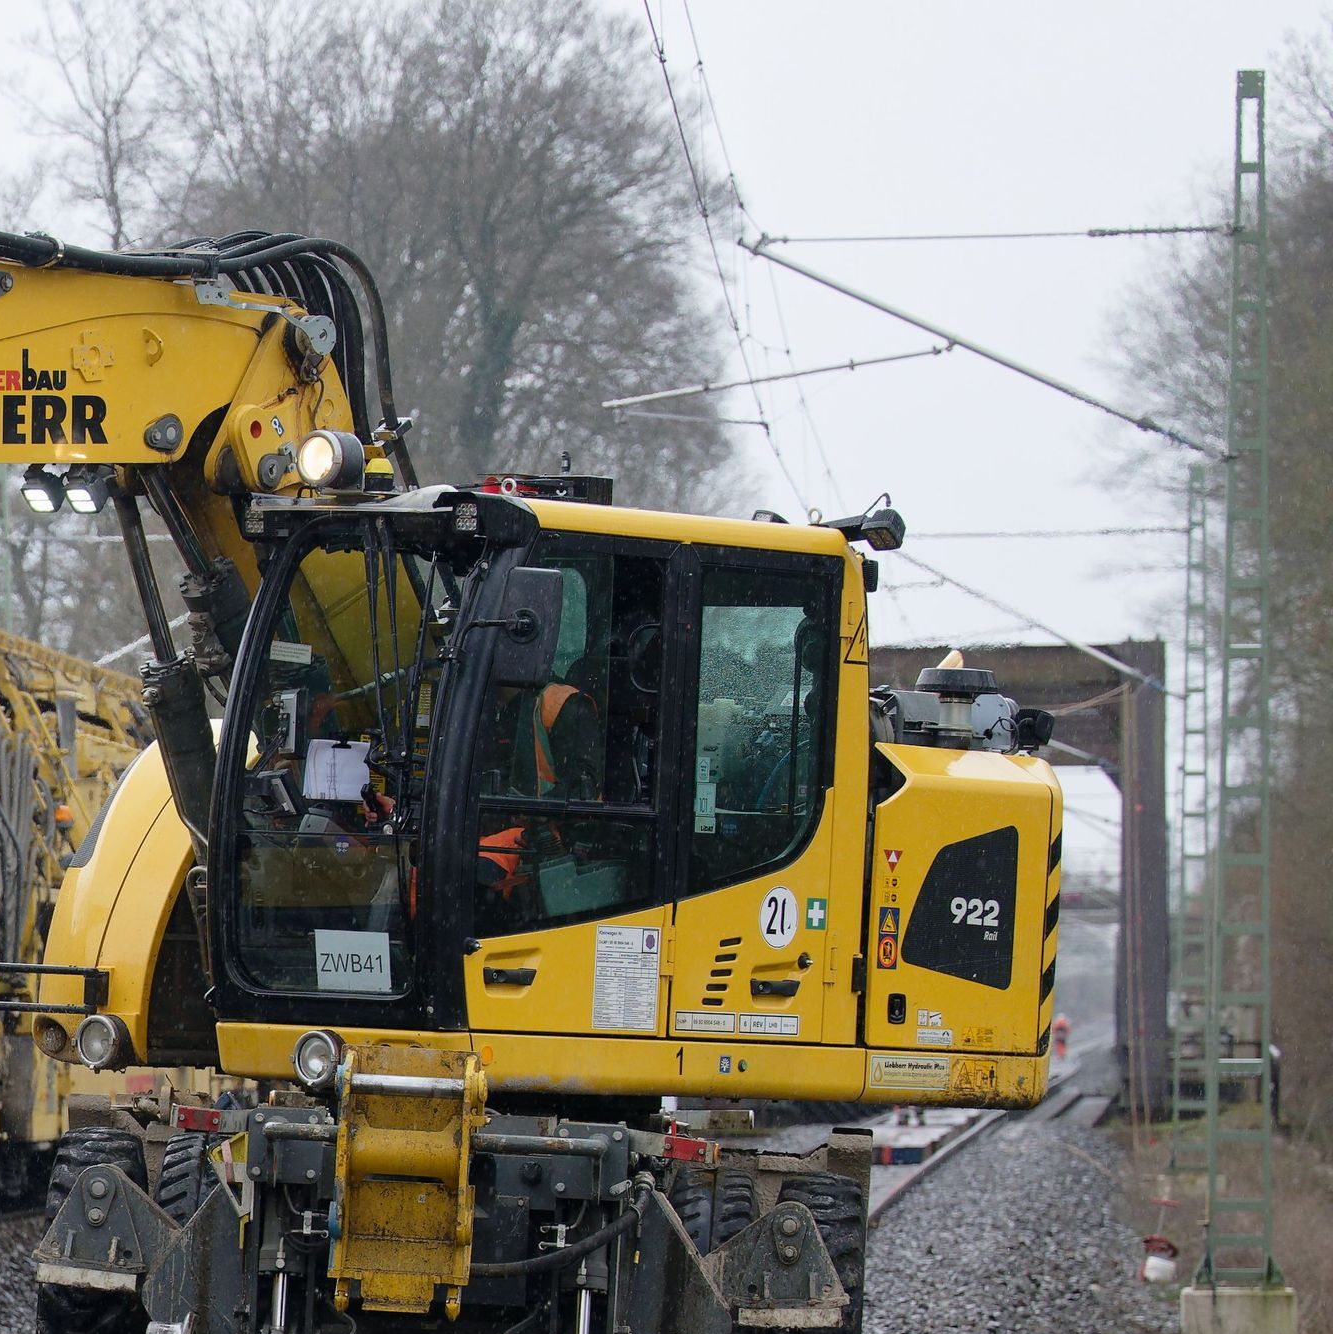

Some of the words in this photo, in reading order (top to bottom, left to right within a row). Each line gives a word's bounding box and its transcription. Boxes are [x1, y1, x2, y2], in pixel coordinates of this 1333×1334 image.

[950, 896, 1000, 927] 922
[983, 930, 999, 941] Rail
[320, 952, 383, 974] ZWB41
[752, 1020, 764, 1029] REV
[676, 1046, 684, 1076] 1
[884, 1061, 907, 1069] Liebherr
[934, 1063, 945, 1071] Plus
